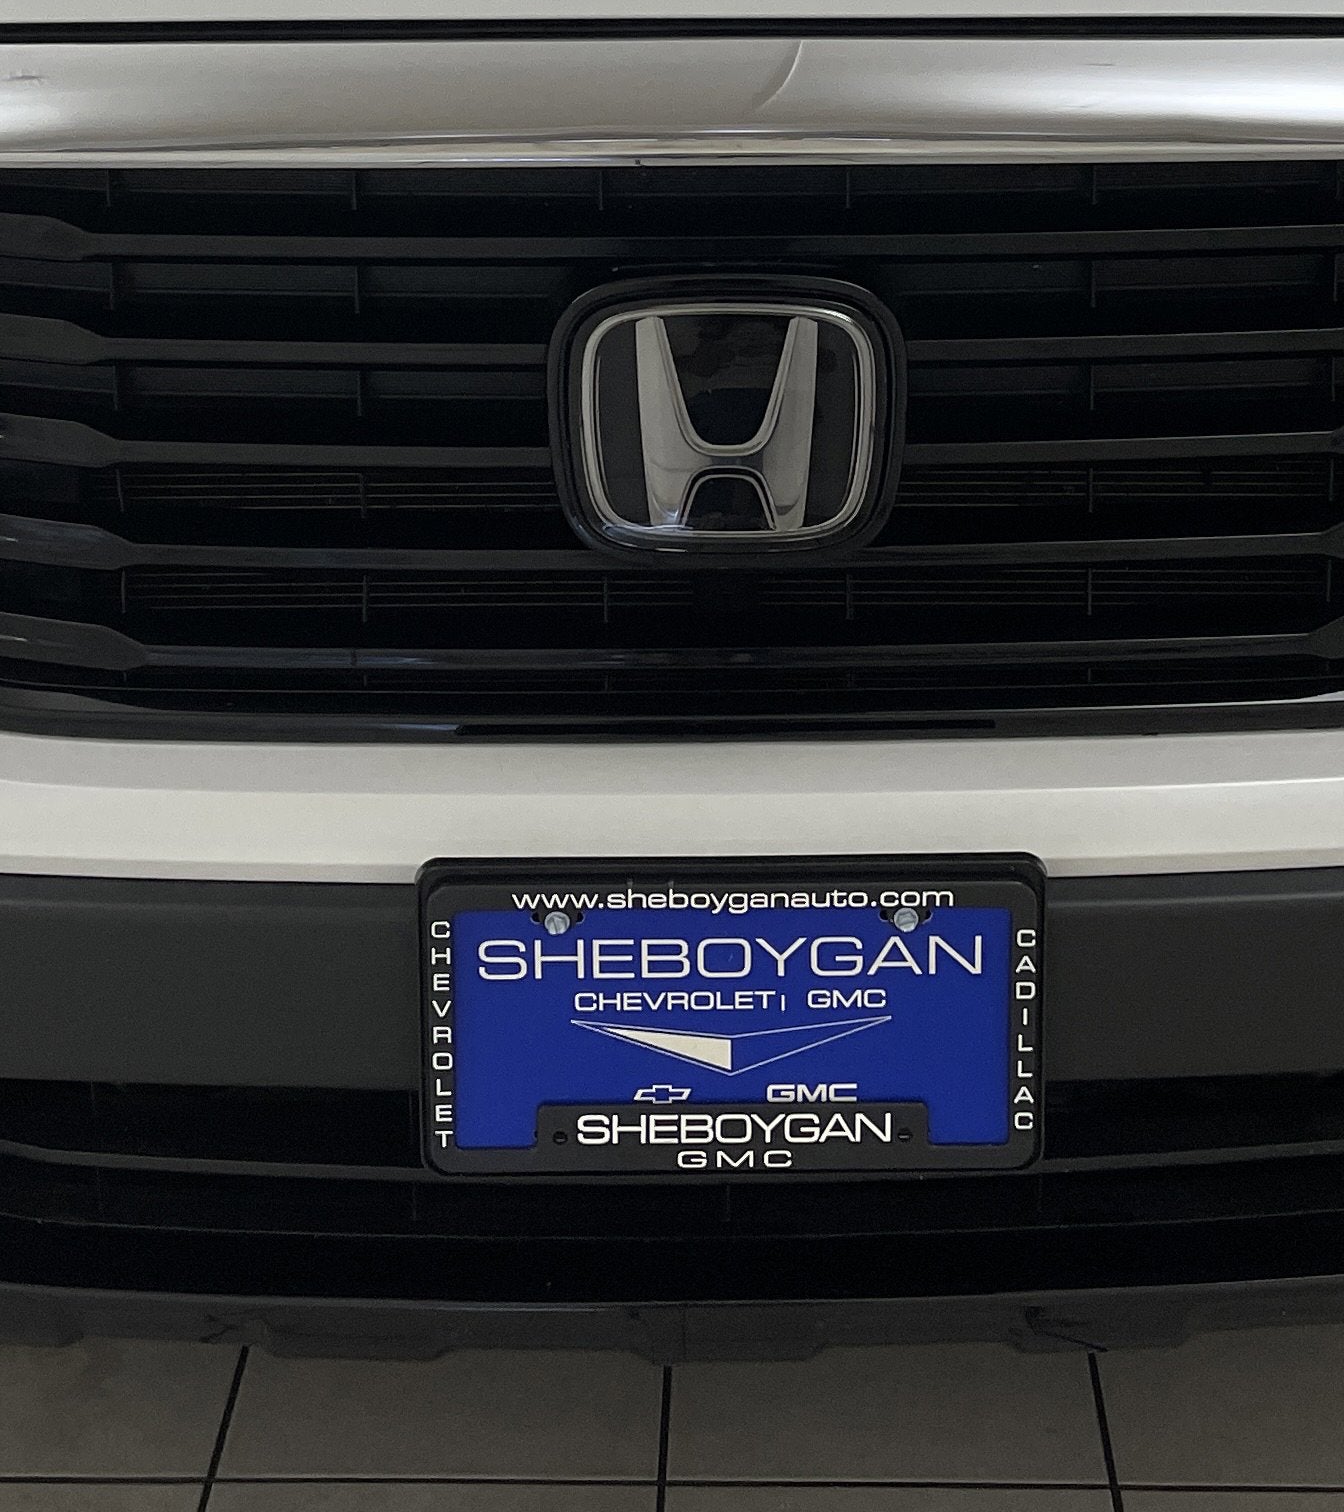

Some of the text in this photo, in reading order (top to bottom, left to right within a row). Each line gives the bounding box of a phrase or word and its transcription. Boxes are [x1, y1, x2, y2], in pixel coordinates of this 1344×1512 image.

[511, 888, 955, 915] www.sheboyganauto.com
[477, 934, 984, 981] SHEBOYGAN
[573, 989, 887, 1012] CHEVROLET GMC
[430, 920, 454, 1149] CHEVROLET
[1013, 928, 1036, 1131] CADILLAC
[766, 1083, 858, 1103] GMC
[576, 1112, 893, 1145] SHEBOYGAN
[677, 1149, 793, 1169] GMC
